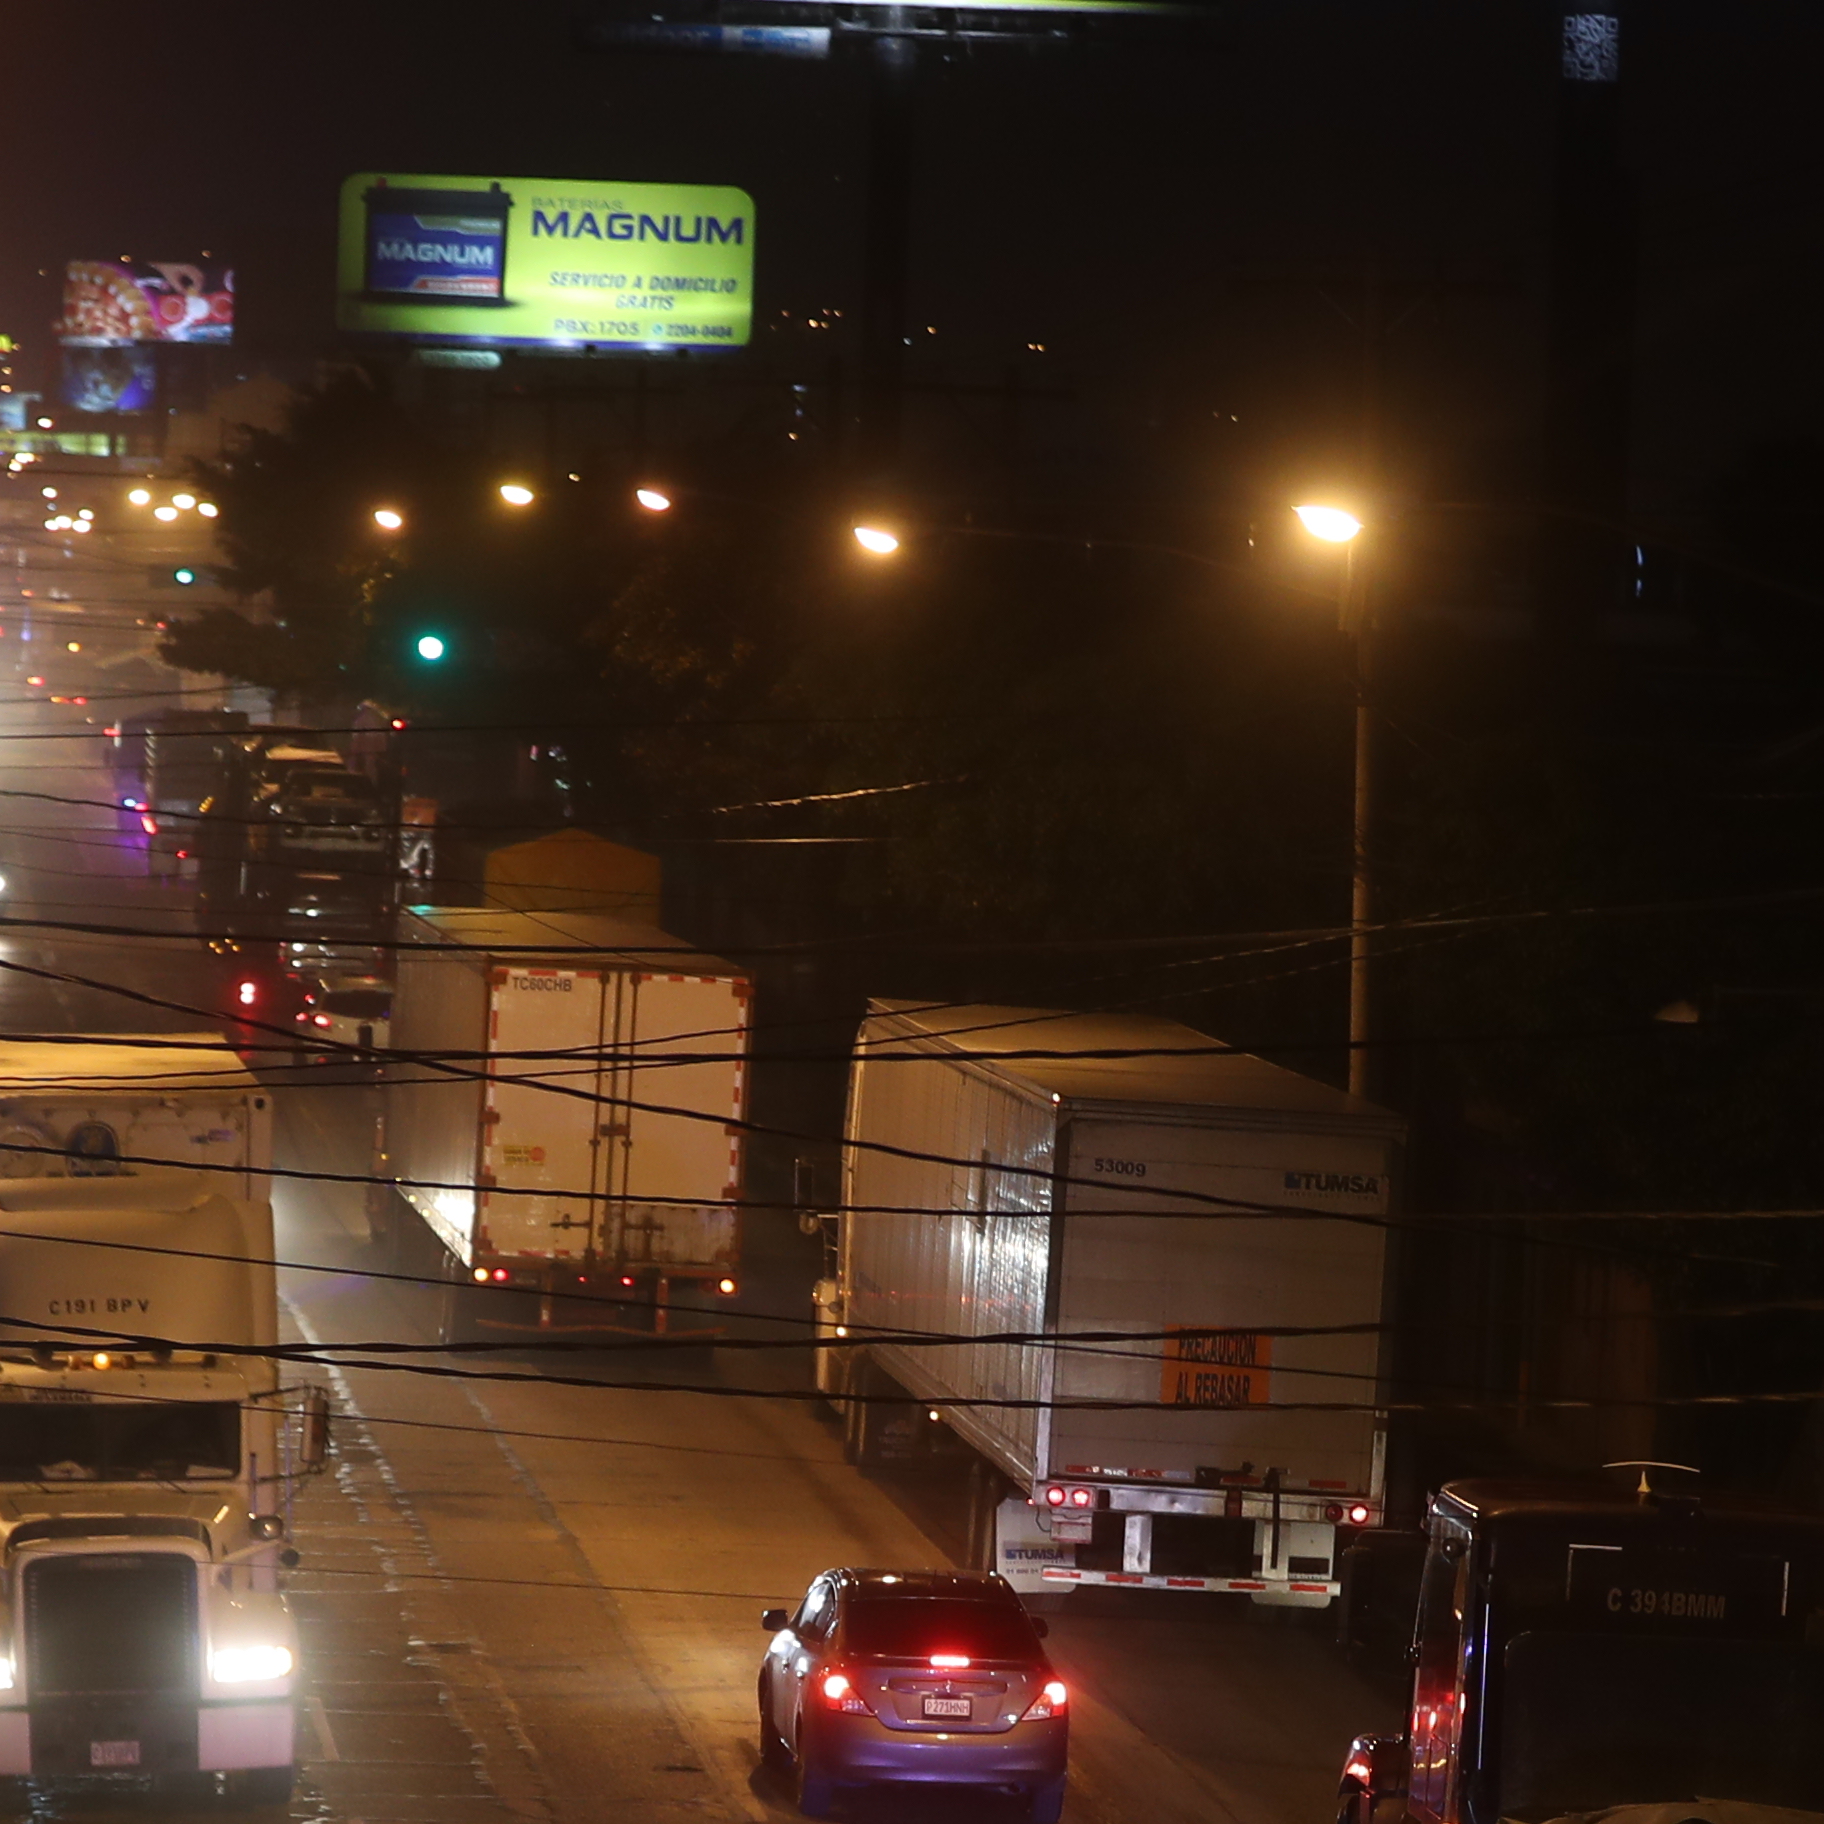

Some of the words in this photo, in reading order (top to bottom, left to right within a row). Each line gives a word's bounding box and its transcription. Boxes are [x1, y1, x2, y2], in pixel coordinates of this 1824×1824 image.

[531, 209, 744, 245] MAGNUM
[376, 241, 495, 266] MAGNUM
[549, 272, 628, 289] SERVICIO
[631, 275, 644, 289] A
[649, 276, 737, 294] DOMICILIO
[615, 294, 674, 310] GRATIS
[1094, 1158, 1147, 1178] 53009
[1303, 1173, 1379, 1195] TUMSA
[1176, 1371, 1190, 1406] AL
[1194, 1373, 1251, 1408] REBASAR
[1016, 1549, 1065, 1561] TUMSA
[1606, 1587, 1623, 1612] C
